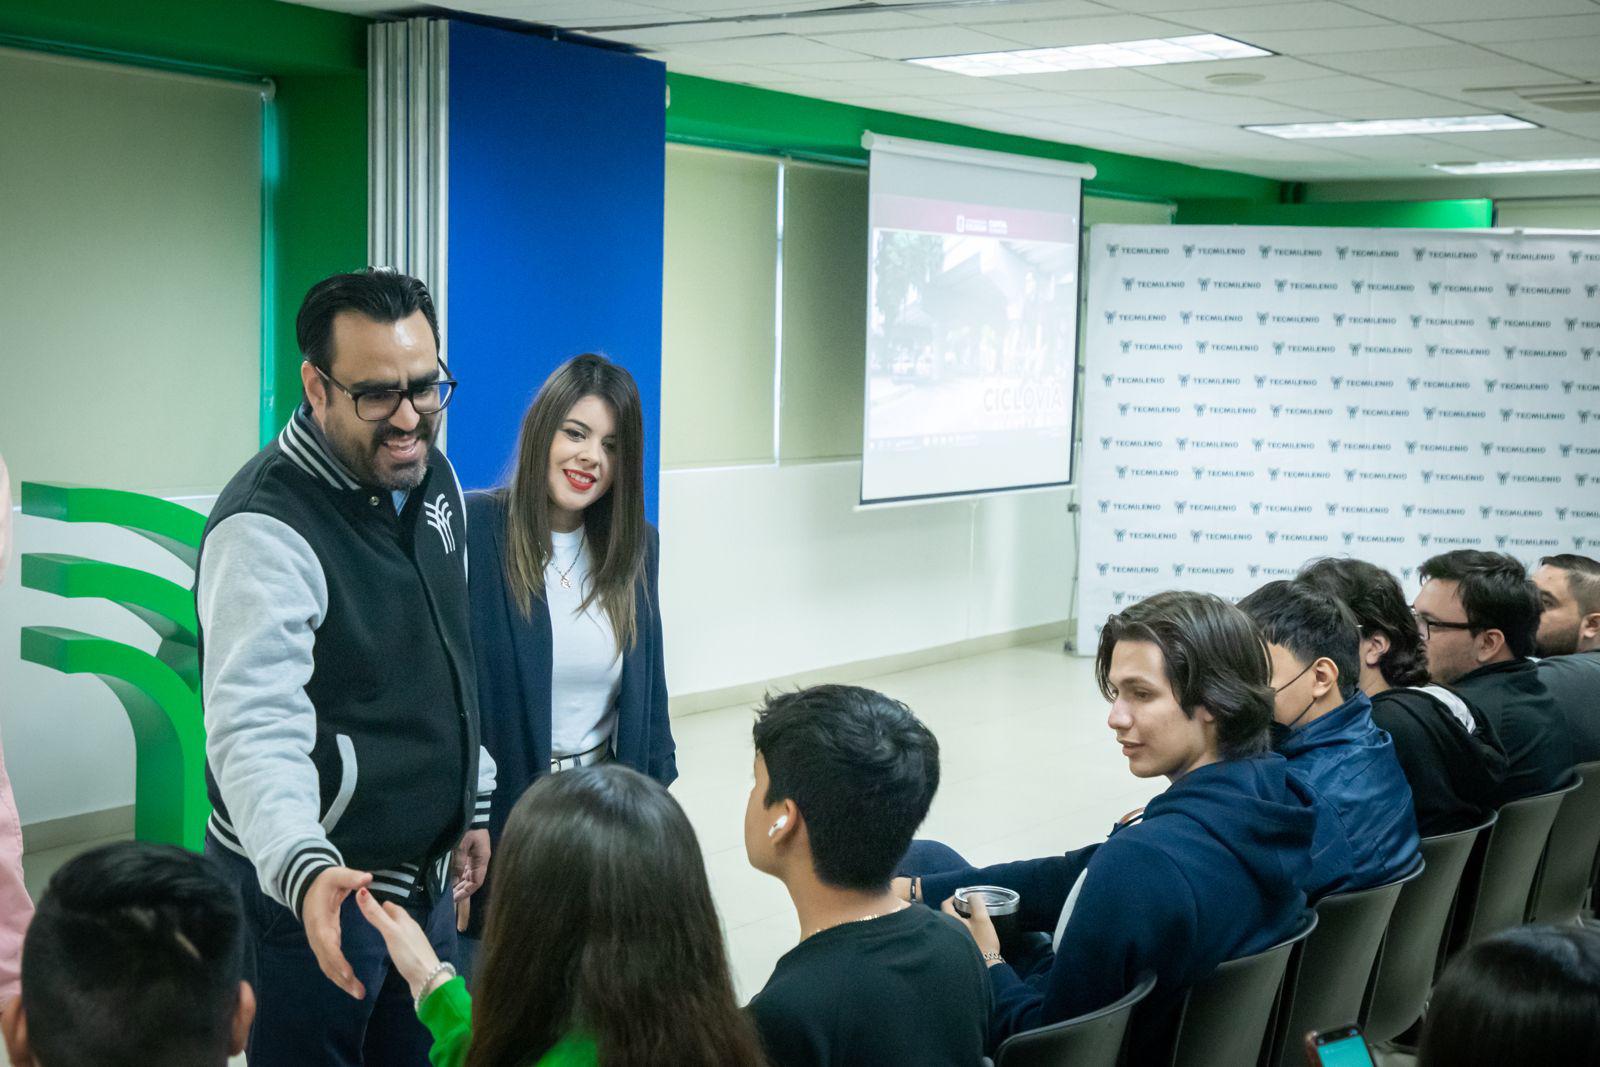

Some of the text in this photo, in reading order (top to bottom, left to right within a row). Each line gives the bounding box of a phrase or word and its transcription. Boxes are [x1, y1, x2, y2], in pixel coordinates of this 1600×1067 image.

[1121, 247, 1169, 255] TECMILENIO
[1198, 247, 1246, 255] TECMILENIO
[1274, 248, 1322, 256] TECMILENIO
[1351, 249, 1399, 257] TECMILENIO
[1428, 251, 1478, 259] TECMILENIO
[1506, 252, 1555, 260] TECMILENIO
[1137, 280, 1185, 288] TECMILENIO
[1213, 281, 1261, 289] TECMILENIO
[1290, 282, 1338, 290] TECMILENIO
[1367, 283, 1415, 291] TECMILENIO
[1444, 285, 1493, 293] TECMILENIO
[1522, 287, 1571, 295] TECMILENIO
[1119, 313, 1167, 321] TECMILENIO
[1196, 314, 1243, 322] TECMILENIO
[1272, 315, 1319, 323] TECMILENIO
[1348, 316, 1396, 324] TECMILENIO
[1426, 318, 1475, 326] TECMILENIO
[1502, 320, 1551, 328] TECMILENIO
[1135, 343, 1183, 351] TECMILENIO
[1211, 343, 1259, 351] TECMILENIO
[1288, 345, 1335, 353] TECMILENIO
[1364, 346, 1412, 354] TECMILENIO
[1441, 347, 1490, 355] TECMILENIO
[1518, 349, 1567, 357] TECMILENIO
[1117, 376, 1165, 384] TECMILENIO
[1193, 377, 1240, 385] TECMILENIO
[1270, 378, 1317, 386] TECMILENIO
[1346, 379, 1394, 387] TECMILENIO
[1423, 381, 1470, 389] TECMILENIO
[1500, 382, 1549, 390] TECMILENIO
[1133, 405, 1180, 413] TECMILENIO
[1210, 406, 1256, 414] TECMILENIO
[1285, 407, 1333, 415] TECMILENIO
[1362, 409, 1409, 417] TECMILENIO
[1438, 410, 1486, 418] TECMILENIO
[1516, 412, 1565, 420] TECMILENIO
[1115, 439, 1162, 447] TECMILENIO
[1192, 440, 1239, 448] TECMILENIO
[1268, 441, 1315, 449] TECMILENIO
[1343, 442, 1391, 450] TECMILENIO
[1420, 444, 1468, 452] TECMILENIO
[1497, 446, 1546, 454] TECMILENIO
[1131, 469, 1179, 477] TECMILENIO
[1208, 469, 1255, 477] TECMILENIO
[1283, 471, 1331, 479] TECMILENIO
[1359, 471, 1407, 479] TECMILENIO
[1435, 473, 1484, 481] TECMILENIO
[1511, 475, 1561, 483] TECMILENIO
[1113, 503, 1161, 511] TECMILENIO
[1189, 503, 1236, 511] TECMILENIO
[1265, 504, 1312, 512] TECMILENIO
[1341, 505, 1389, 513] TECMILENIO
[1415, 507, 1465, 515] TECMILENIO
[1494, 509, 1543, 517] TECMILENIO
[1571, 510, 1600, 518] TECMIL
[1129, 532, 1177, 540] TECMILENIO
[1205, 532, 1252, 540] TECMILENIO
[1281, 533, 1328, 541] TECMILENIO
[1357, 535, 1405, 543] TECMILENIO
[1432, 536, 1481, 544] TECMILENIO
[1510, 538, 1559, 546] TECMILENIO
[1112, 566, 1159, 574] TECMILENIO
[1187, 566, 1234, 574] TECMILENIO
